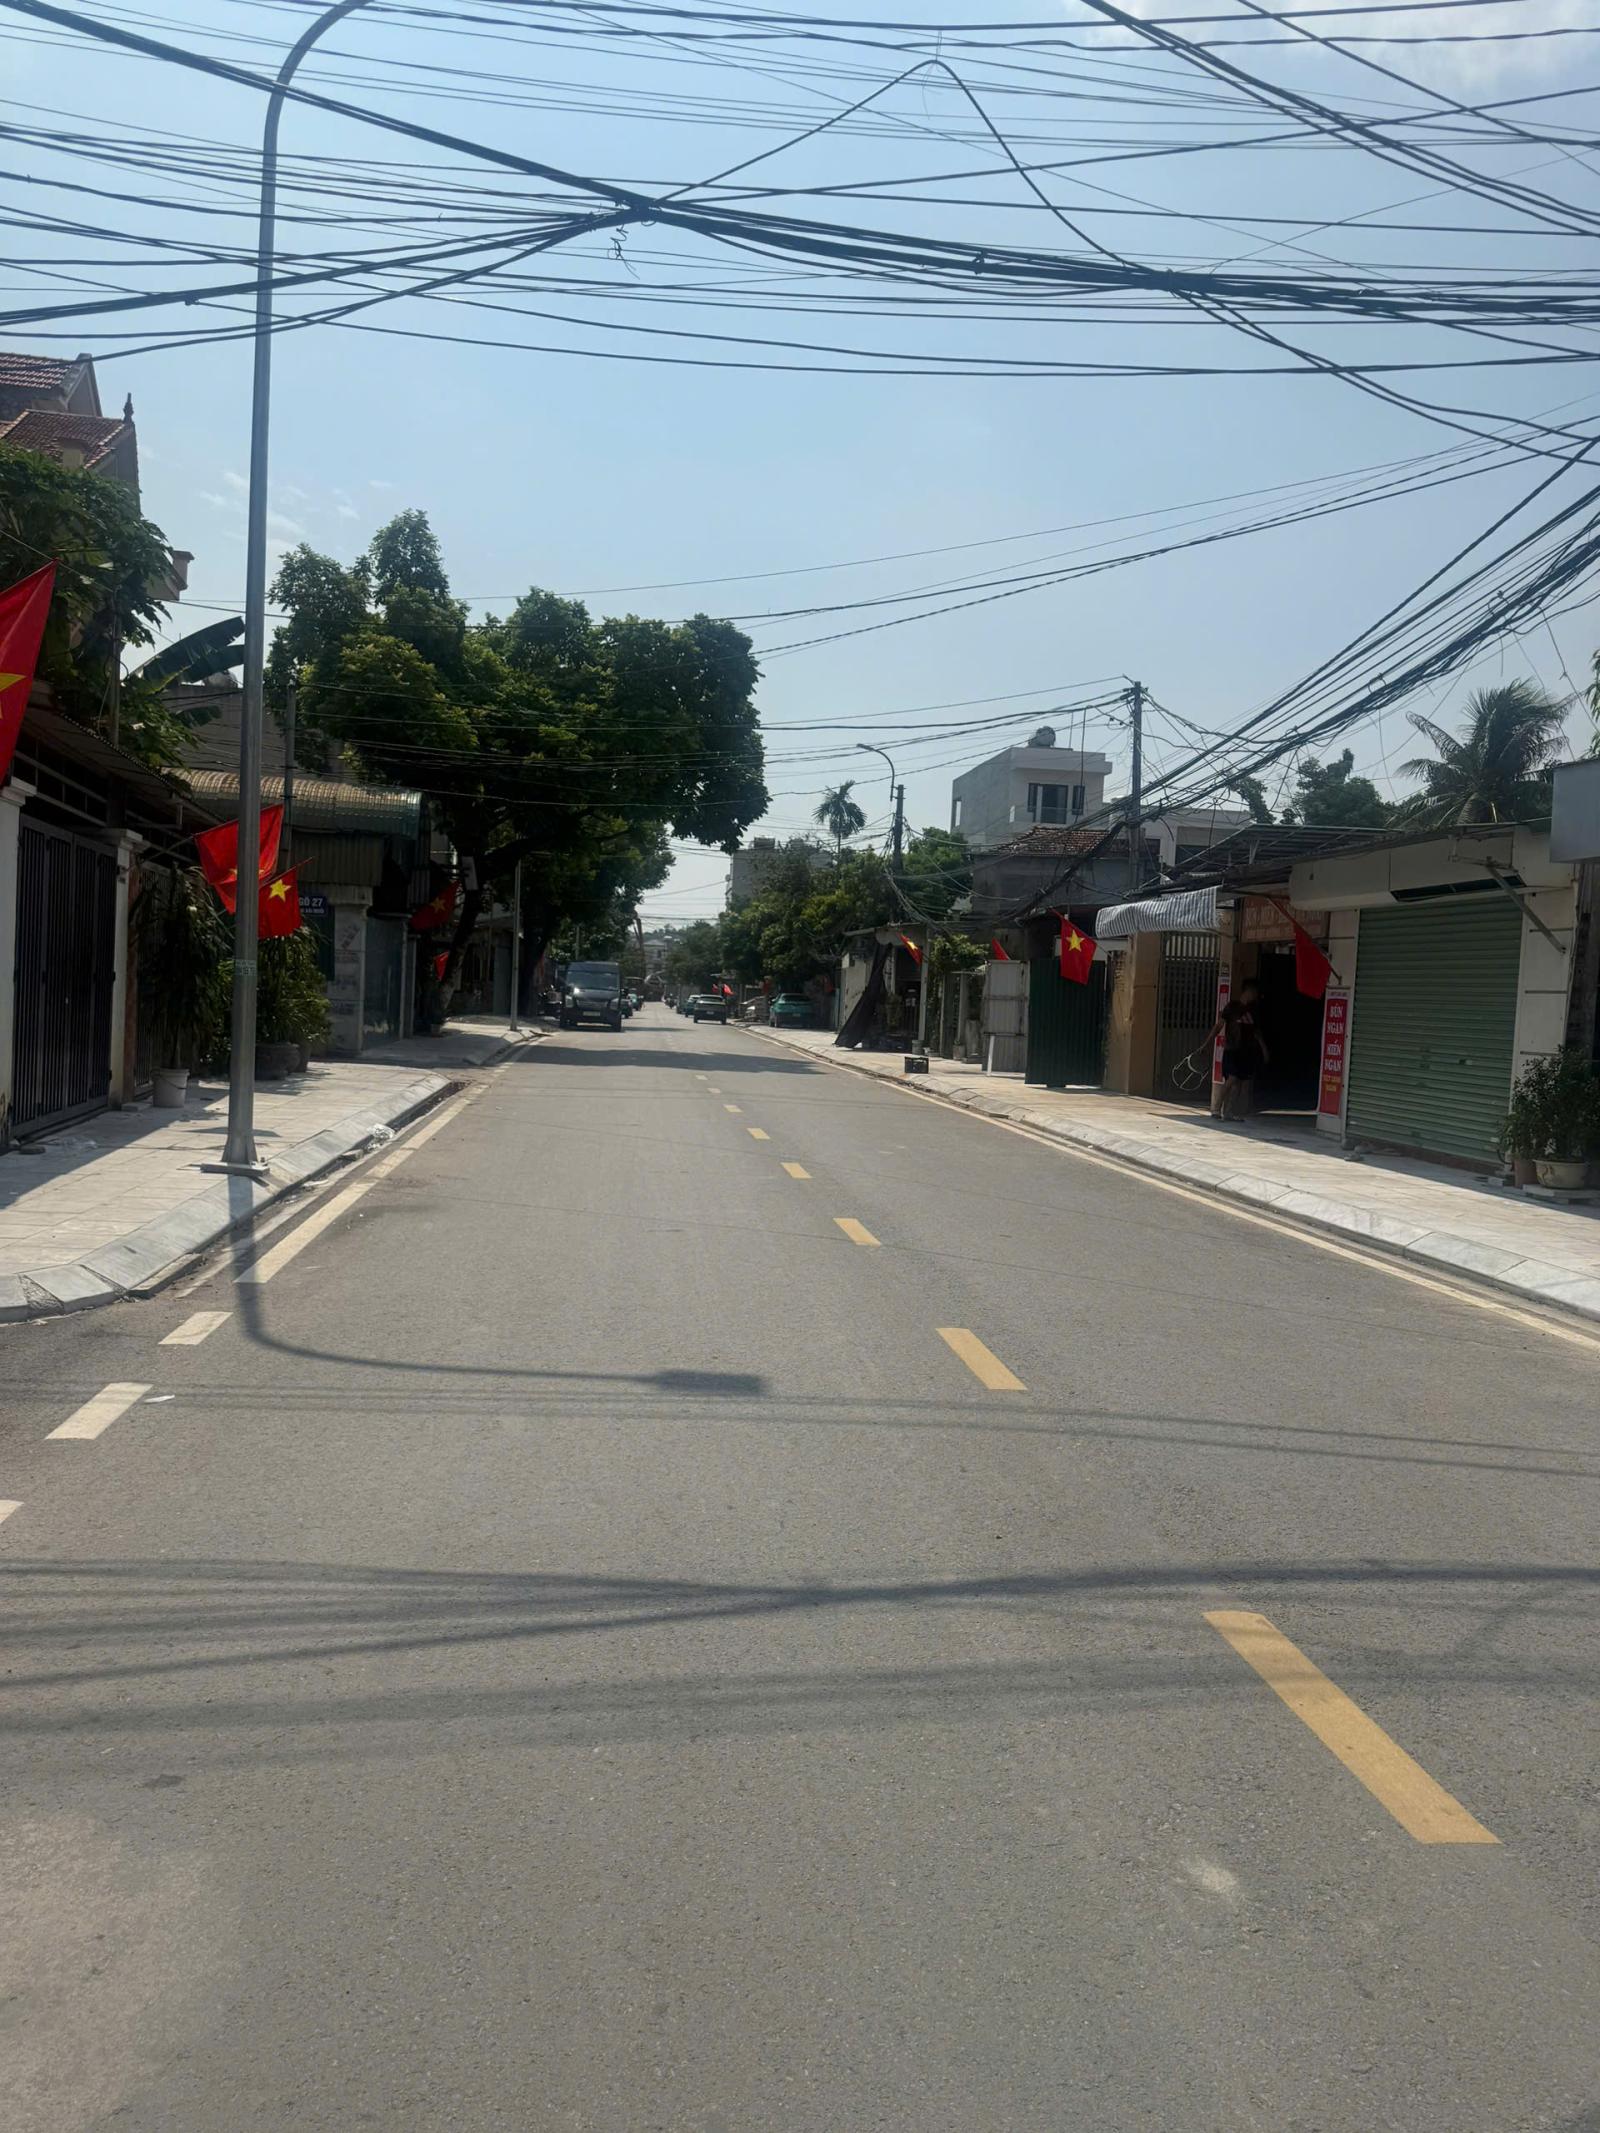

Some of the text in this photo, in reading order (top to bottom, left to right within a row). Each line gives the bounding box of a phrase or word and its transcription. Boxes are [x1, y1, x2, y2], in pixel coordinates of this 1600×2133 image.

[311, 897, 323, 907] 27
[1326, 1022, 1344, 1035] NGAN
[1324, 1059, 1342, 1072] NGAN
